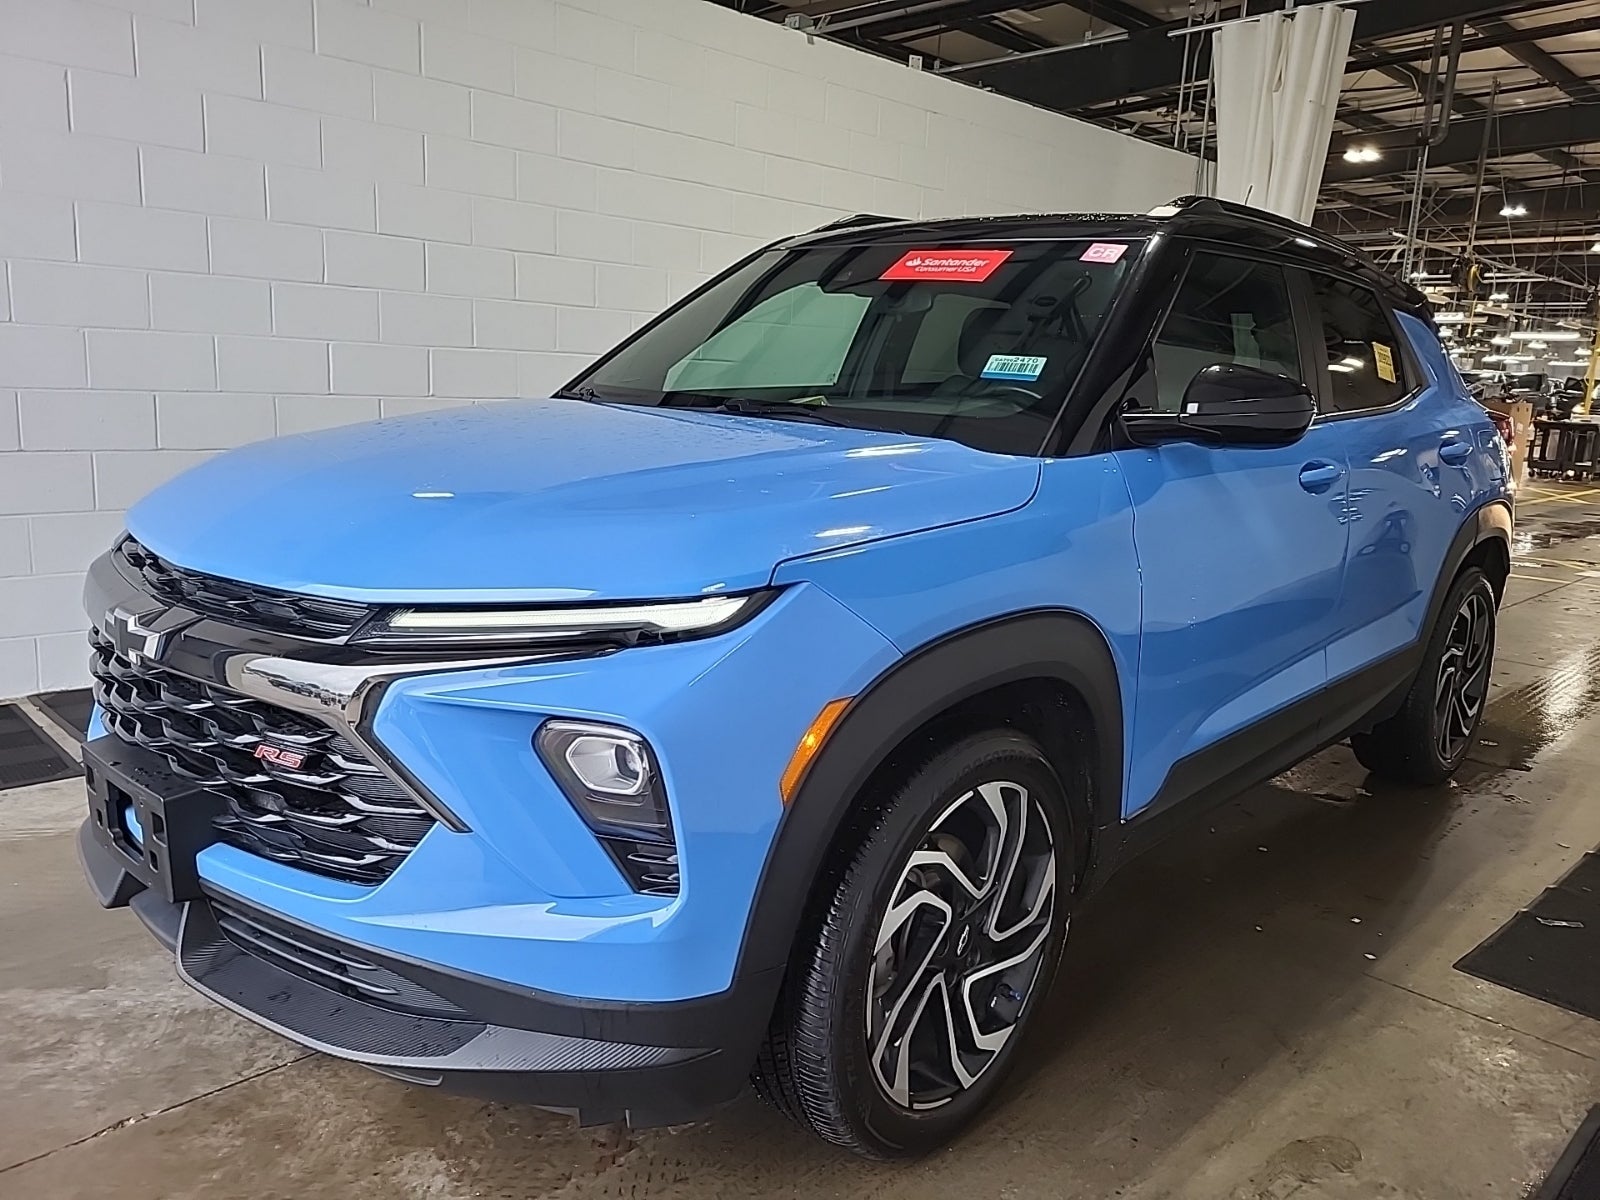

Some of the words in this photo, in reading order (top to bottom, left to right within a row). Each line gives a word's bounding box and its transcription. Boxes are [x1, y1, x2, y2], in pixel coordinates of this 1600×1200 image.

[1089, 247, 1118, 259] CR
[921, 258, 990, 267] Santander
[254, 744, 305, 769] RS
